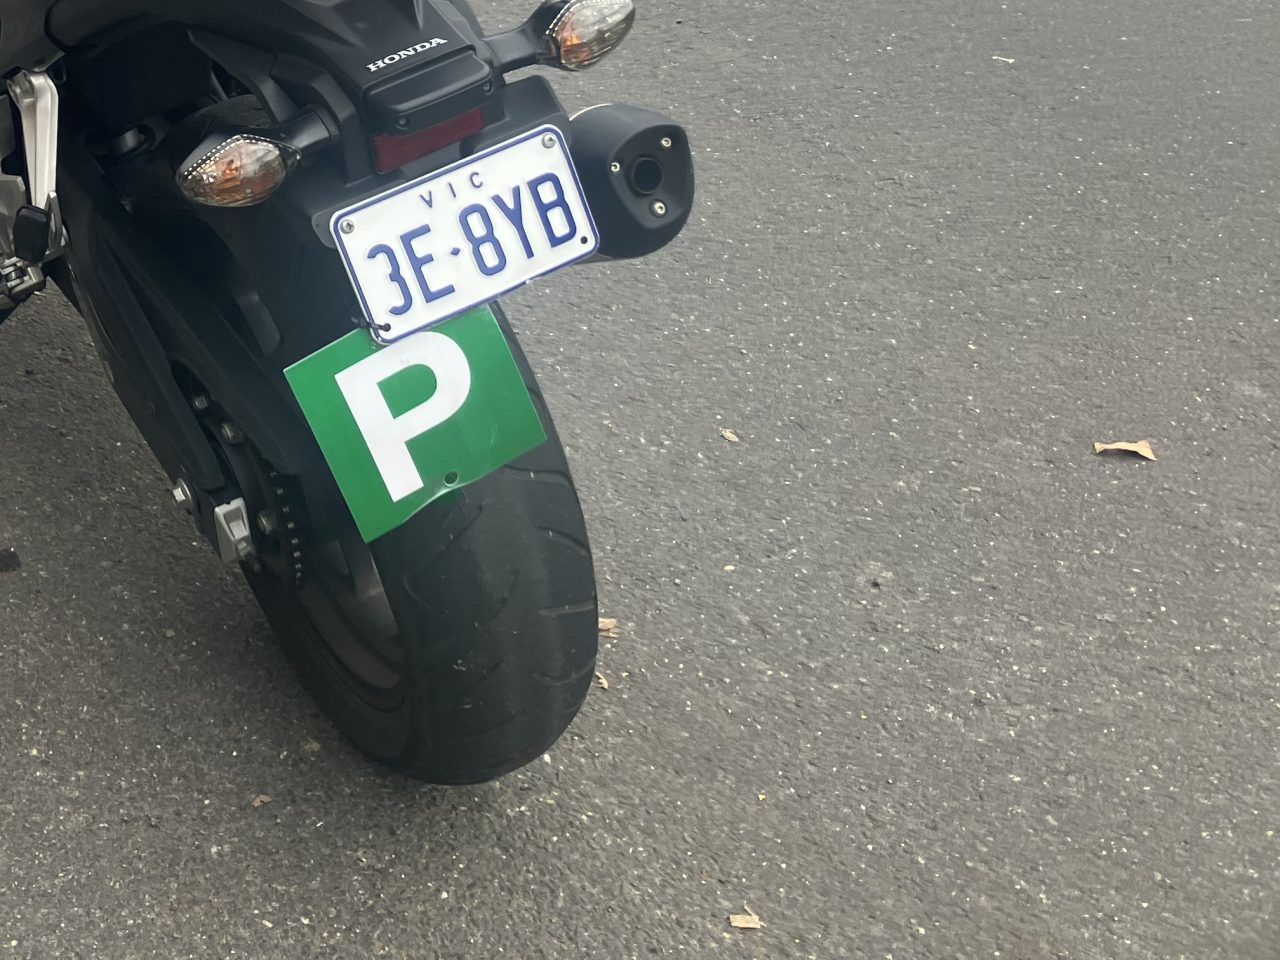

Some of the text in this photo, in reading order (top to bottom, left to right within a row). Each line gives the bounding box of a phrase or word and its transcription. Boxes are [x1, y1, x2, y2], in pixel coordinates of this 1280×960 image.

[366, 36, 448, 73] HONDA
[420, 171, 485, 209] VIC
[335, 331, 472, 503] P
